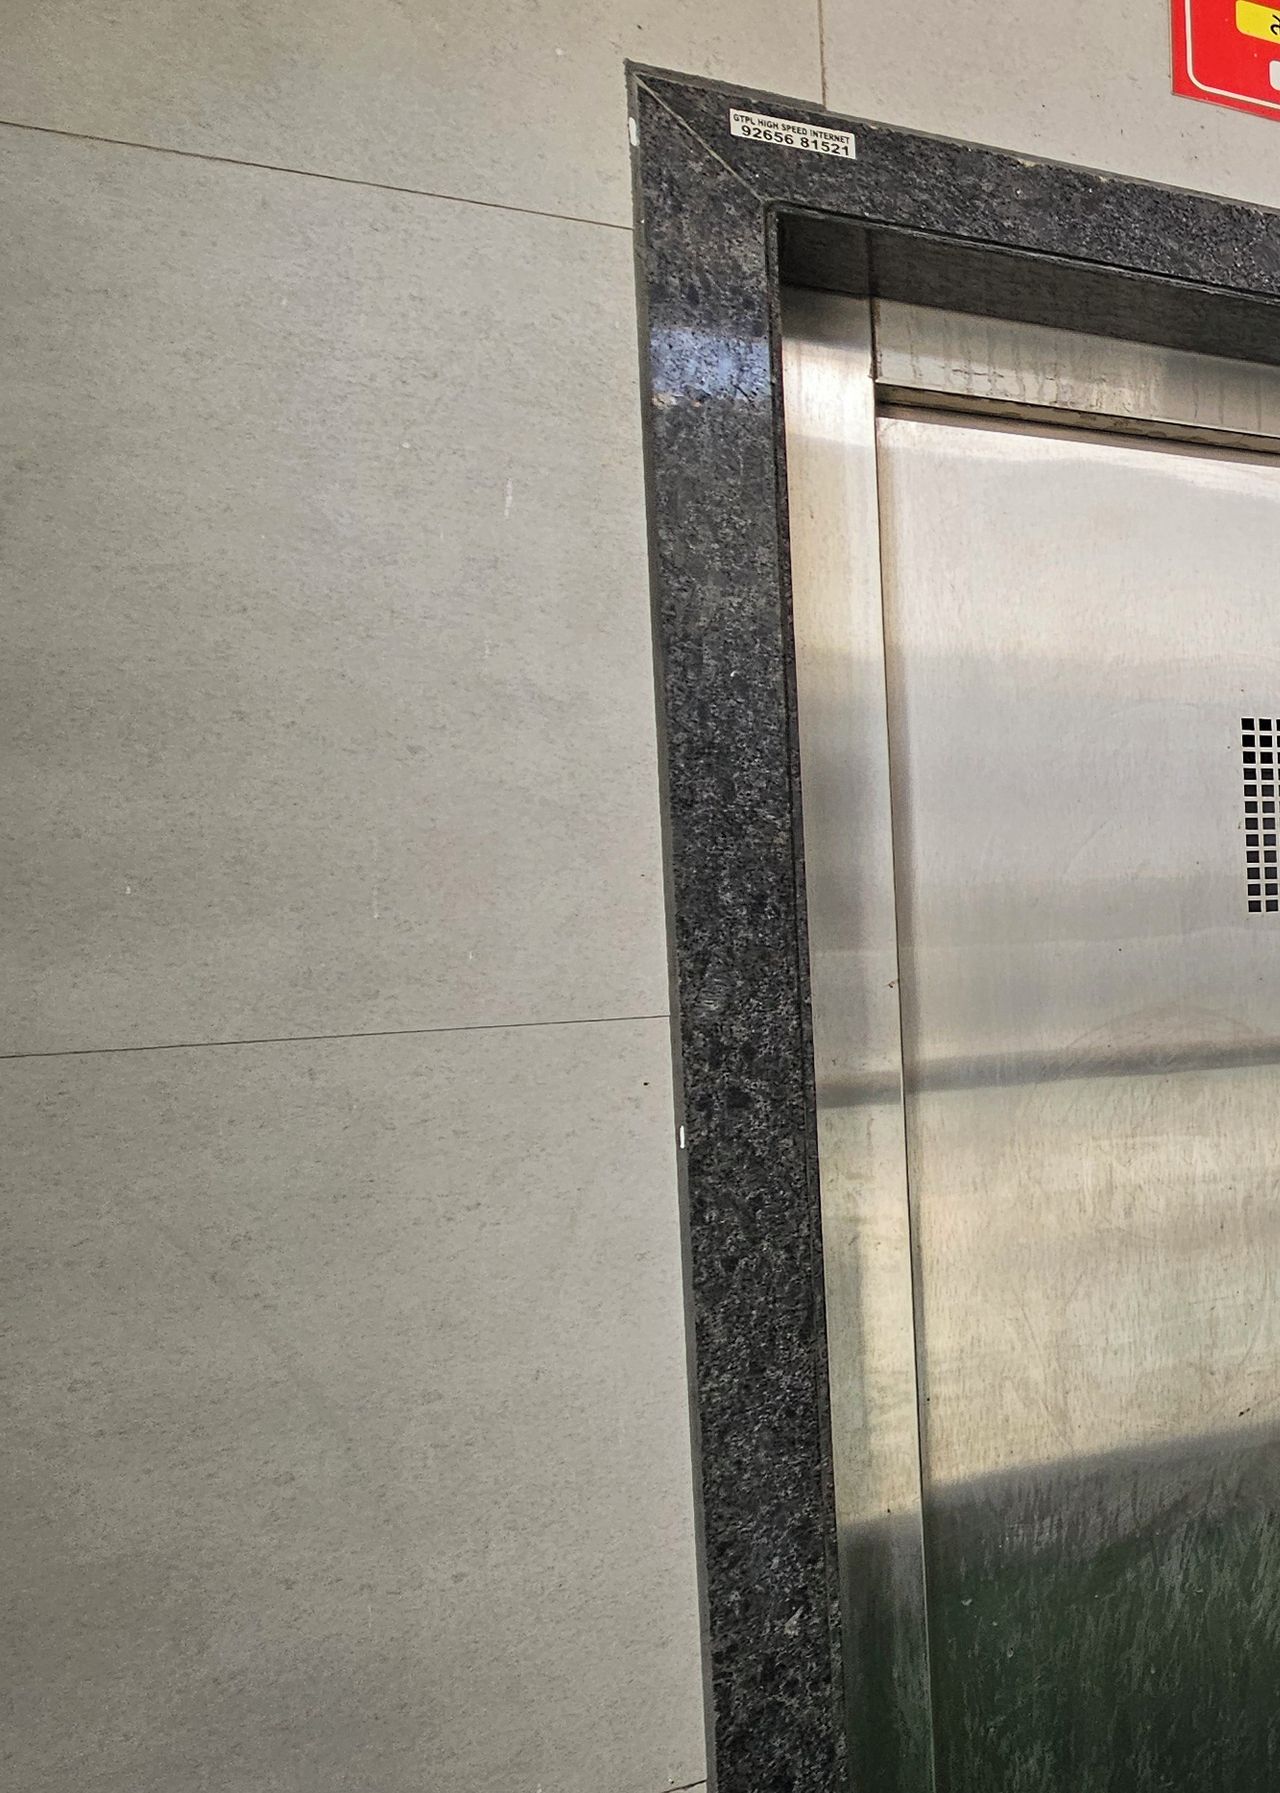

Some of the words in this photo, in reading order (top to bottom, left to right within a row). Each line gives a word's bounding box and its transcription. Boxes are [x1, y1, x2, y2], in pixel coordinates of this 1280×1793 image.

[733, 113, 755, 125] GTPL
[758, 119, 779, 130] HIGH
[781, 122, 807, 136] SPEED
[810, 129, 850, 143] INTERNET
[741, 124, 794, 145] 92656
[800, 136, 849, 156] 81521
